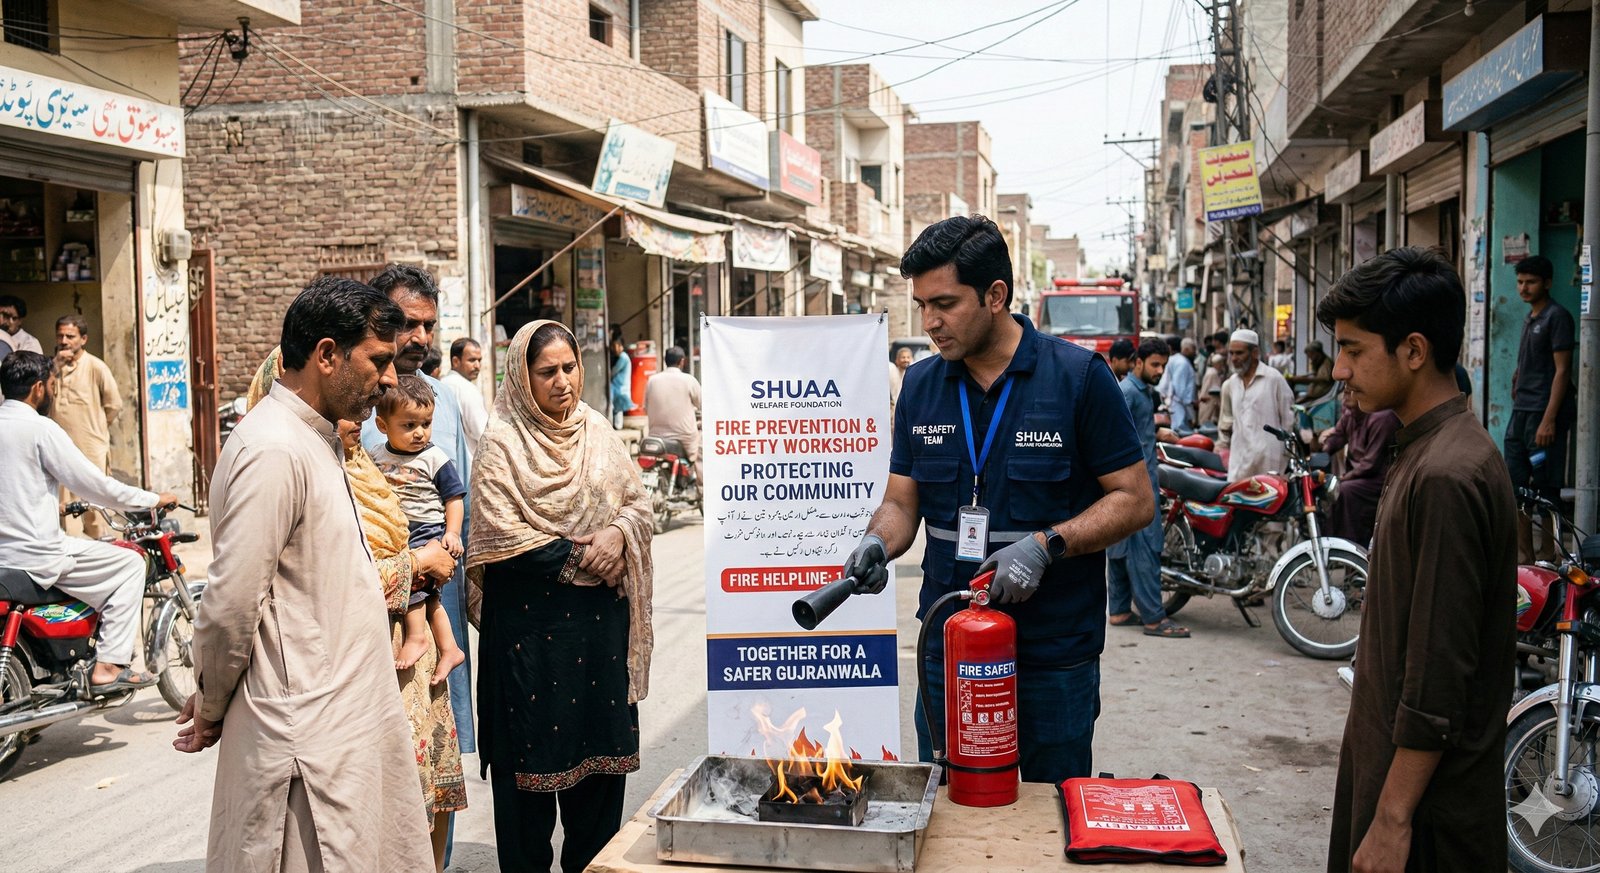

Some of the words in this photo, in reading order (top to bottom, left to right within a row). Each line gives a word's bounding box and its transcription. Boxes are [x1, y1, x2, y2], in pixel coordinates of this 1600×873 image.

[751, 380, 841, 399] SHUAA
[716, 420, 751, 435] FIRE
[756, 418, 860, 435] PREVENTION
[866, 418, 876, 433] &
[913, 426, 926, 434] FIRE
[928, 425, 956, 434] SAFETY
[924, 436, 942, 444] TEAM
[1016, 432, 1062, 442] SHUAA
[715, 439, 778, 455] SAFETY
[784, 437, 878, 454] WORKSHOP
[742, 462, 853, 479] PROTECTING
[722, 485, 758, 501] OUR
[764, 482, 874, 500] COMMUNITY
[730, 573, 759, 586] FIRE
[763, 572, 832, 587] HELPLINE:
[737, 645, 817, 661] TOGETHER
[822, 645, 851, 659] FOR
[855, 644, 866, 658] A
[724, 667, 772, 681] SAFER
[776, 664, 881, 680] GUJRANWALA
[960, 665, 982, 676] FIRE
[985, 662, 1016, 676] SAFETY
[1095, 822, 1149, 830] SAFETY
